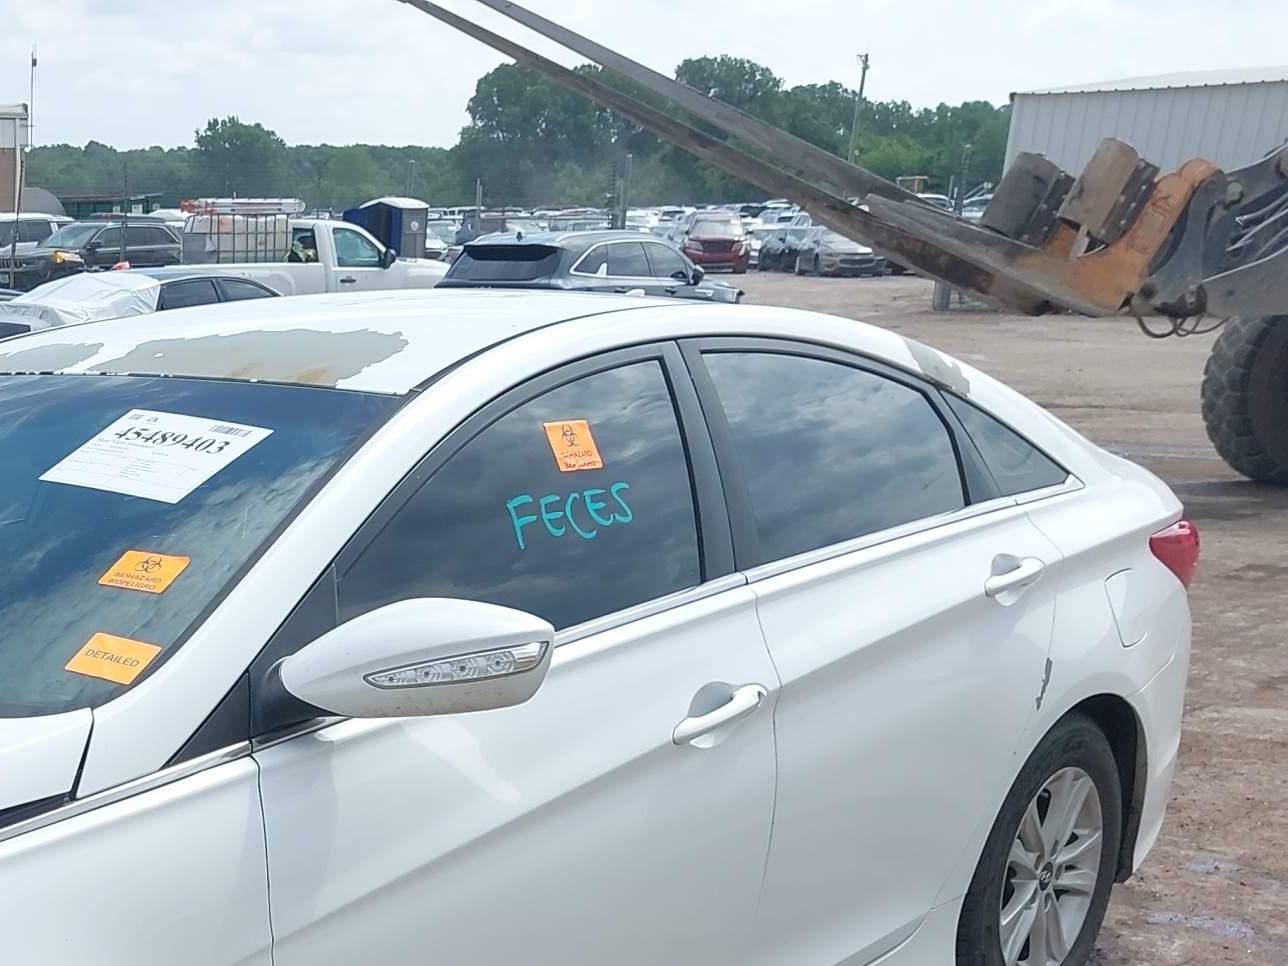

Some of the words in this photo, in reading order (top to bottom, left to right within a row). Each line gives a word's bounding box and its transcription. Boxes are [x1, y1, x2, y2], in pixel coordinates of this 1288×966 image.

[114, 426, 231, 454] 45489403
[505, 482, 633, 550] FECES
[85, 648, 140, 667] DETAILED
